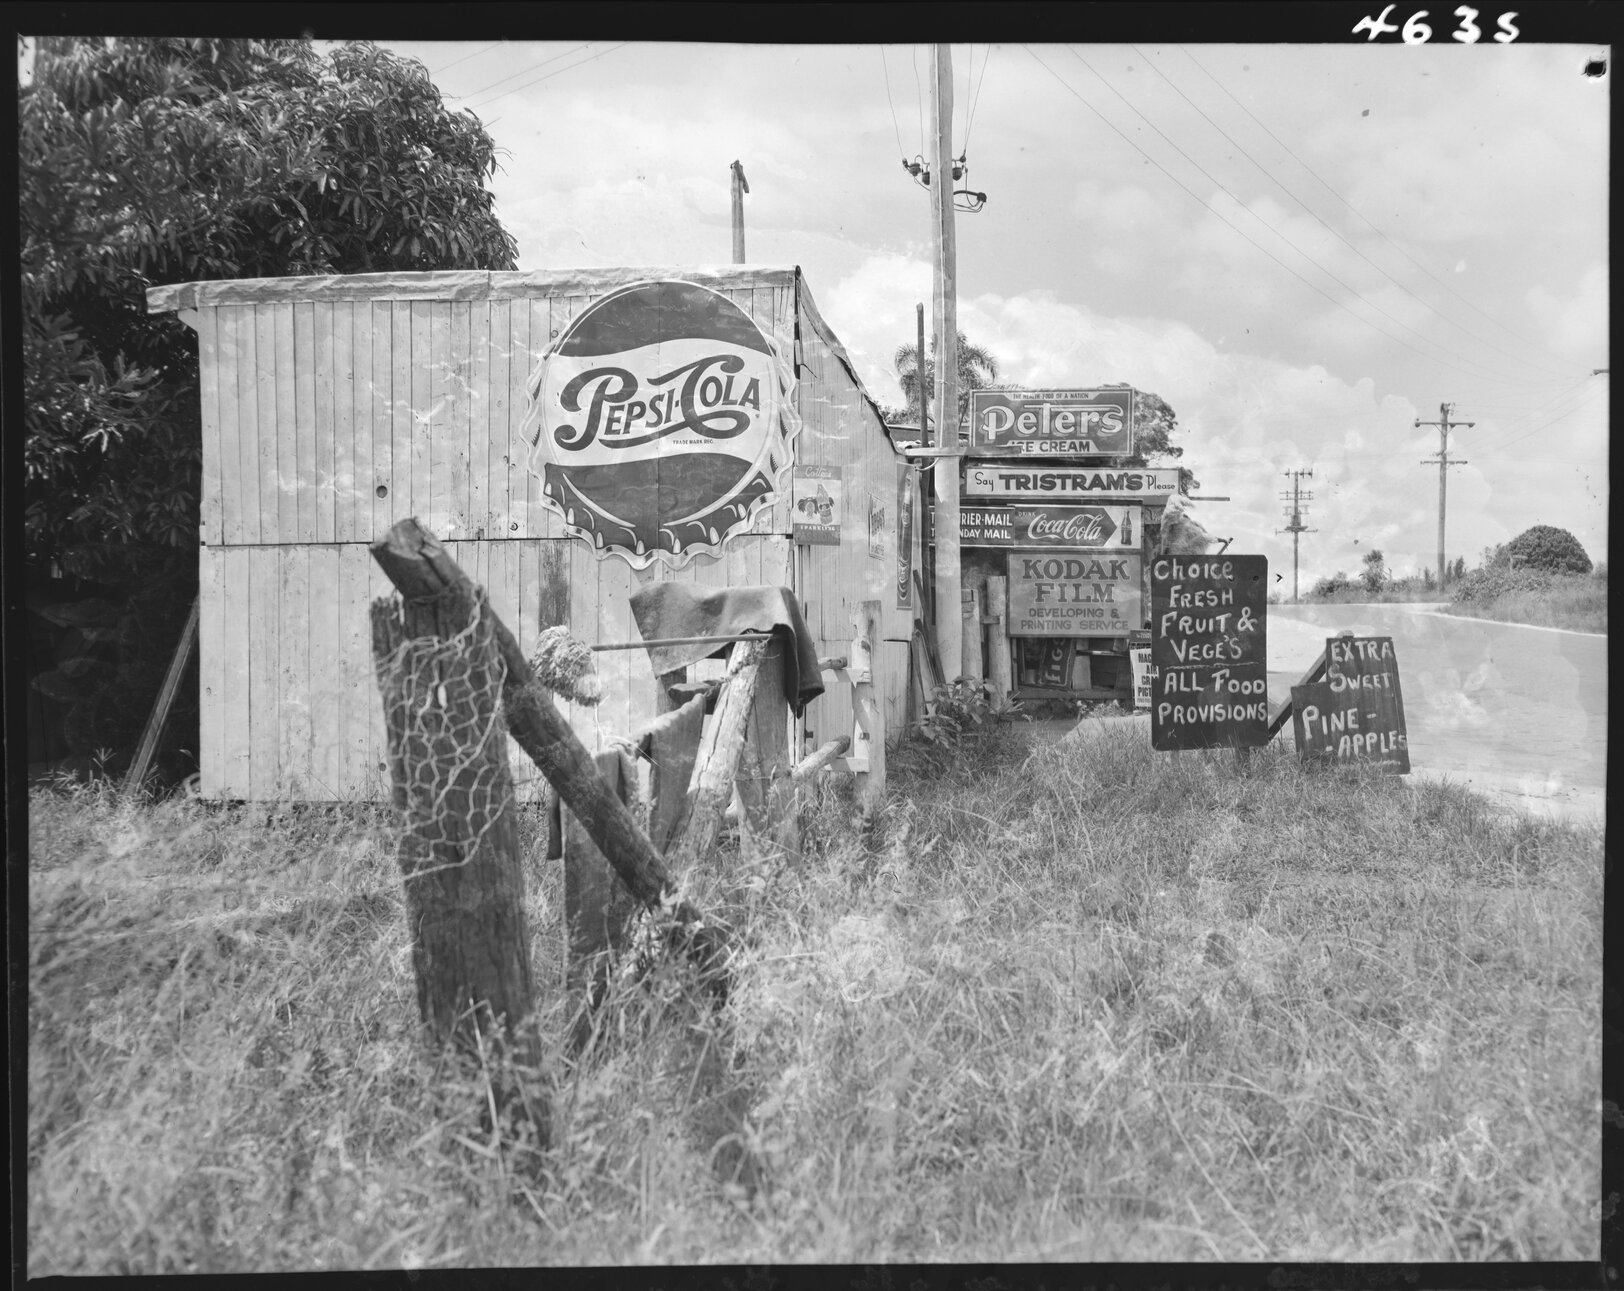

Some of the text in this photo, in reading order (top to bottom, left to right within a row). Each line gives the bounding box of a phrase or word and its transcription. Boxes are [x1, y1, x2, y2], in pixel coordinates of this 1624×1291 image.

[553, 354, 760, 451] PEPSI-COLA
[981, 402, 1125, 440] Peters
[1039, 441, 1090, 452] CREAM
[974, 472, 1176, 491] Say TRISTRAM'S Please
[960, 512, 1012, 526] RIER-MAIL
[1028, 513, 1105, 540] Coca-Cola
[984, 529, 1011, 539] MAIL
[1022, 560, 1130, 580] KODAK
[1034, 583, 1115, 603] FILM
[1169, 584, 1234, 608] FRESH
[1029, 608, 1120, 618] DEVELOPING &
[1160, 606, 1258, 638] FRUIT &
[1020, 620, 1128, 630] PRINTING SERVICE
[1330, 640, 1394, 662] EXTRA
[1164, 668, 1266, 696] ALL FOOD
[1328, 663, 1390, 692] SWEET
[1158, 702, 1268, 726] PROVISIONS
